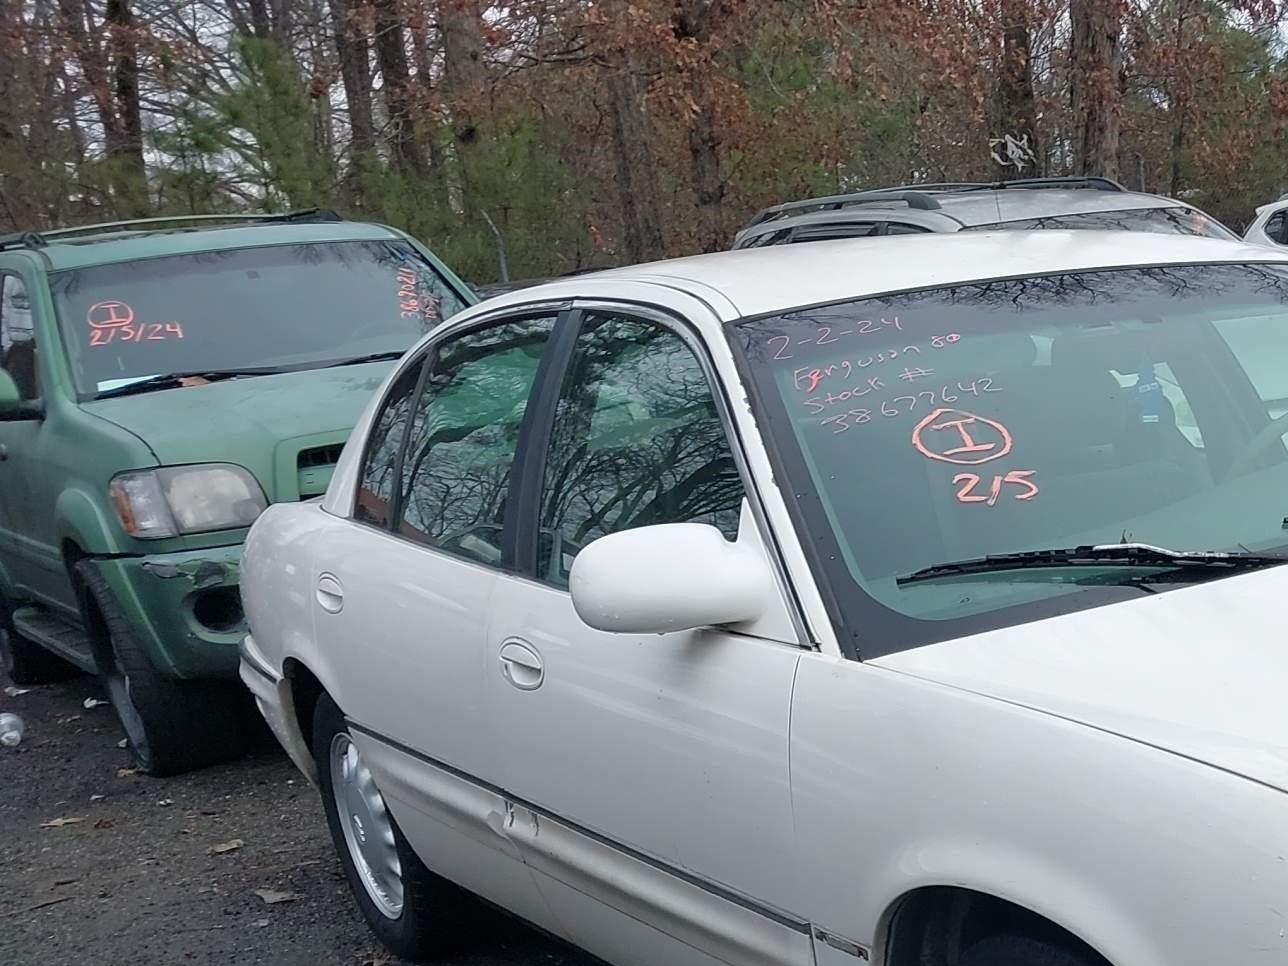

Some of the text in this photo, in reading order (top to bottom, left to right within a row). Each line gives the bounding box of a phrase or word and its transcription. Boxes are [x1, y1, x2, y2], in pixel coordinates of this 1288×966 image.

[89, 321, 184, 346] 2/5/24
[768, 316, 902, 360] 2-2-24
[804, 367, 937, 415] Stock #
[821, 378, 1004, 433] 38677642
